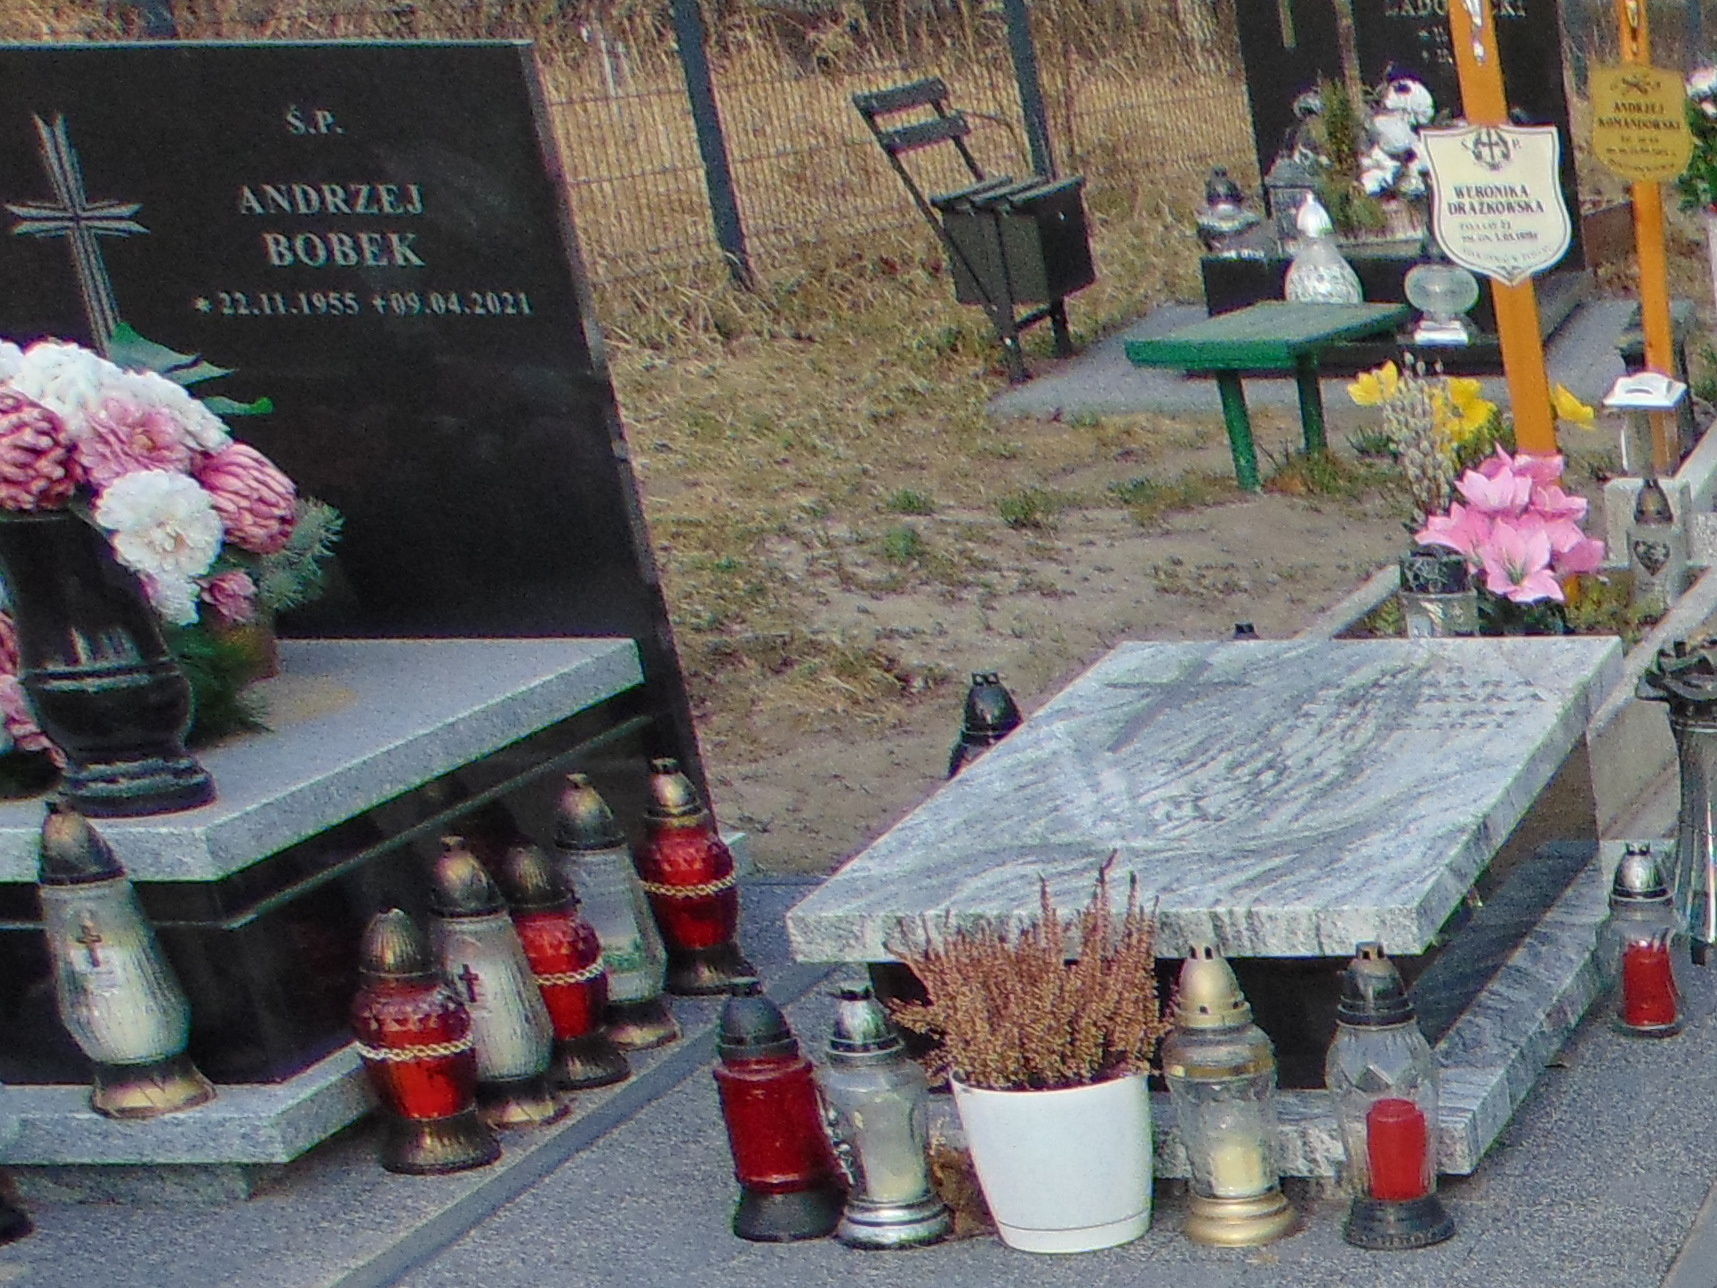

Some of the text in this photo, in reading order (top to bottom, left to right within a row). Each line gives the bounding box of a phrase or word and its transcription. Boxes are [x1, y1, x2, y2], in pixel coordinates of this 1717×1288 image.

[239, 183, 424, 215] ANDRZEJ
[1453, 183, 1530, 200] WERONIKA
[261, 232, 426, 268] BOBEK
